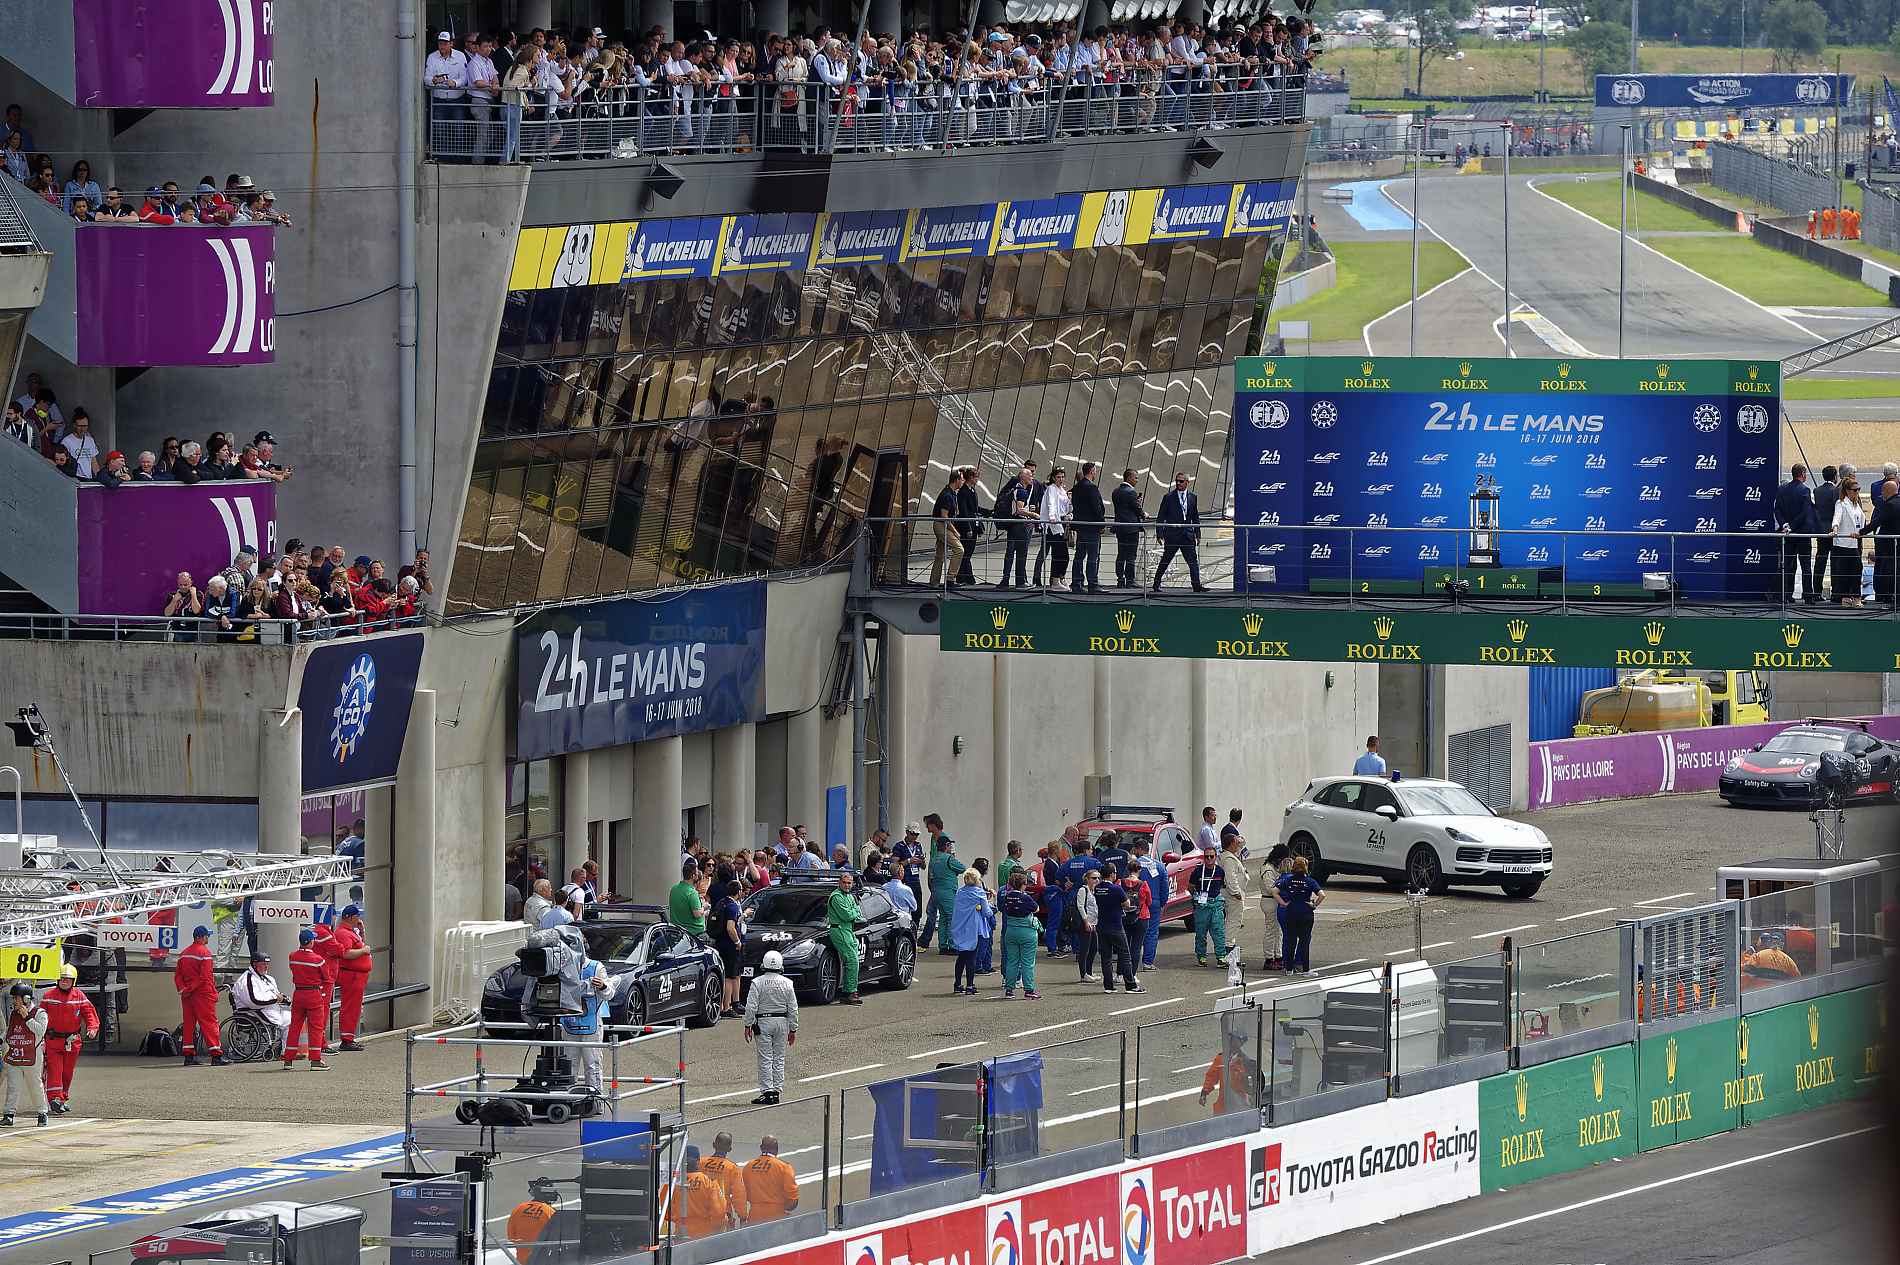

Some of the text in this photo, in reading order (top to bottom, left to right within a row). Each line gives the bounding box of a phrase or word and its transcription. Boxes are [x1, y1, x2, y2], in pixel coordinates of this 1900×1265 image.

[1711, 79, 1741, 88] ACTION
[1169, 203, 1226, 226] MICHELIN
[929, 219, 990, 244] MICHELIN
[1016, 213, 1076, 237] MICHELIN
[745, 231, 810, 257] MICHELIN
[837, 226, 900, 251] MICHELIN
[646, 238, 714, 263] MICHELIN
[1247, 378, 1293, 389] ROLEX
[1344, 378, 1391, 389] ROLEX
[1441, 379, 1488, 390] ROLEX
[1540, 380, 1587, 391] ROLEX
[1639, 381, 1687, 391] ROLEX
[1735, 381, 1771, 393] ROLEX
[1424, 401, 1604, 432] 24h LE MANS
[1520, 434, 1600, 445] 16-17 JUIN 2018
[1261, 449, 1281, 460] 24h
[1368, 451, 1388, 462] 24h
[1476, 452, 1496, 464] 24h
[1585, 453, 1606, 465] 24h
[1696, 454, 1717, 465] 24h
[1314, 481, 1334, 493] 24h
[1421, 483, 1442, 494] 24h
[1531, 484, 1551, 496] 24h
[1640, 485, 1661, 497] 24h
[1745, 486, 1761, 498] 24h
[1260, 511, 1280, 523] 24h
[1367, 513, 1388, 525] 24h
[1585, 515, 1606, 528] 24h
[1696, 517, 1717, 529] 24h
[1311, 543, 1331, 555] 24h
[1419, 544, 1439, 557] 24h
[1528, 546, 1549, 558] 24h
[1638, 548, 1659, 560] 24h
[1745, 548, 1761, 560] 24h
[1361, 582, 1369, 592] 2
[1477, 575, 1486, 589] 1
[1593, 584, 1601, 596] 3
[964, 633, 1034, 650] ROLEX
[1088, 637, 1160, 653] ROLEX
[1216, 640, 1289, 657] ROLEX
[1346, 643, 1421, 660] ROLEX
[1479, 646, 1556, 663] ROLEX
[1615, 649, 1693, 666] ROLEX
[1752, 651, 1832, 668] ROLEX
[535, 625, 706, 713] 24h LE MANS
[645, 696, 702, 723] 16-17 JUIN 2018
[1677, 752, 1699, 769] PAYS
[1701, 751, 1713, 767] DE
[1714, 750, 1726, 766] LA
[1553, 760, 1614, 782] PAYS DE LA LOIRE
[1744, 780, 1770, 788] Safety Car
[1367, 828, 1386, 845] 24h
[258, 903, 330, 921] TOYOTA 7
[102, 927, 174, 948] TOYOTA 8
[16, 953, 41, 974] 80
[660, 973, 673, 994] 24h
[1795, 1056, 1836, 1092] ROLEX
[1723, 1073, 1765, 1110] ROLEX
[1651, 1092, 1692, 1128] ROLEX
[1578, 1109, 1622, 1147] ROLEX
[1501, 1128, 1545, 1168] ROLEX
[1250, 1126, 1477, 1207] GR TOYOTA GAZOO Racing
[1160, 1184, 1242, 1243] TOTAL
[147, 1241, 169, 1253] 50
[1028, 1216, 1115, 1265] TOTAL
[429, 1249, 455, 1259] VISION
